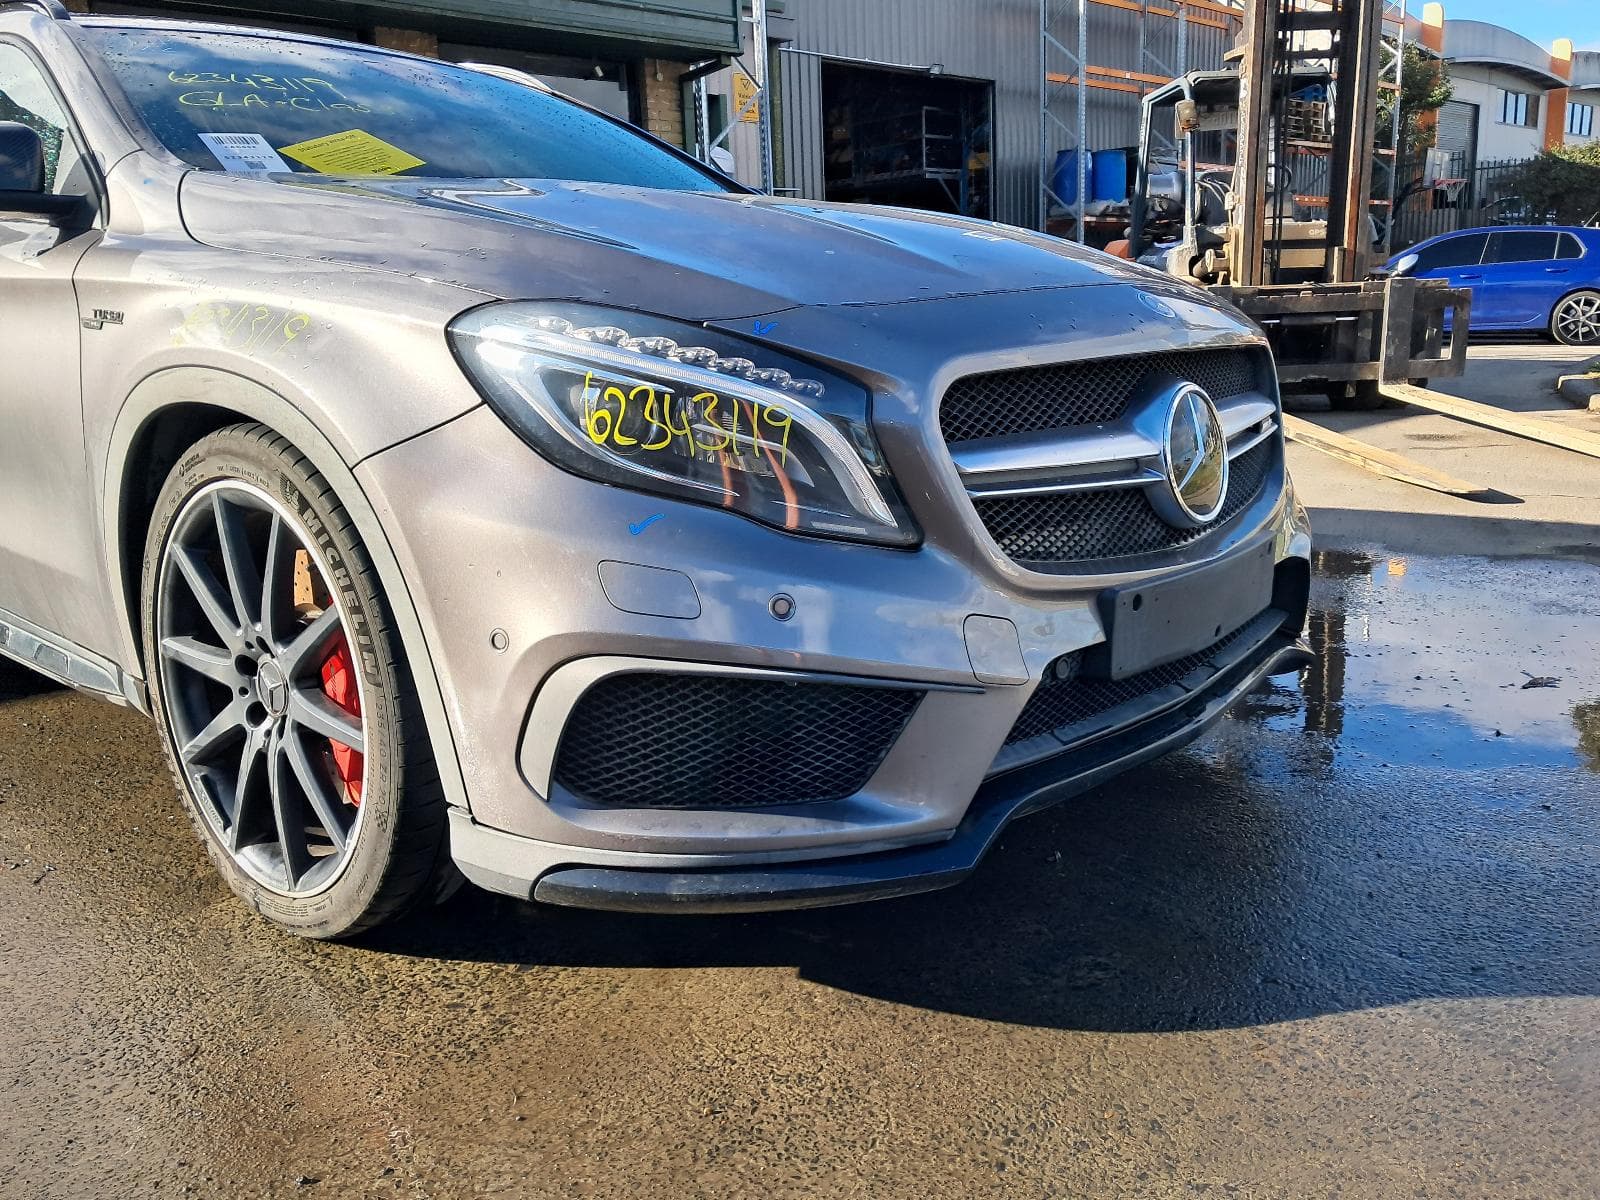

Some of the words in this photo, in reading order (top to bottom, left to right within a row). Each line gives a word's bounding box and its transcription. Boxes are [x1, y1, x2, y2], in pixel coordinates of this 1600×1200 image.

[168, 71, 347, 99] 62343119
[91, 308, 124, 323] TURBO
[584, 370, 792, 468] 62343119
[302, 507, 383, 689] MICHELIN
